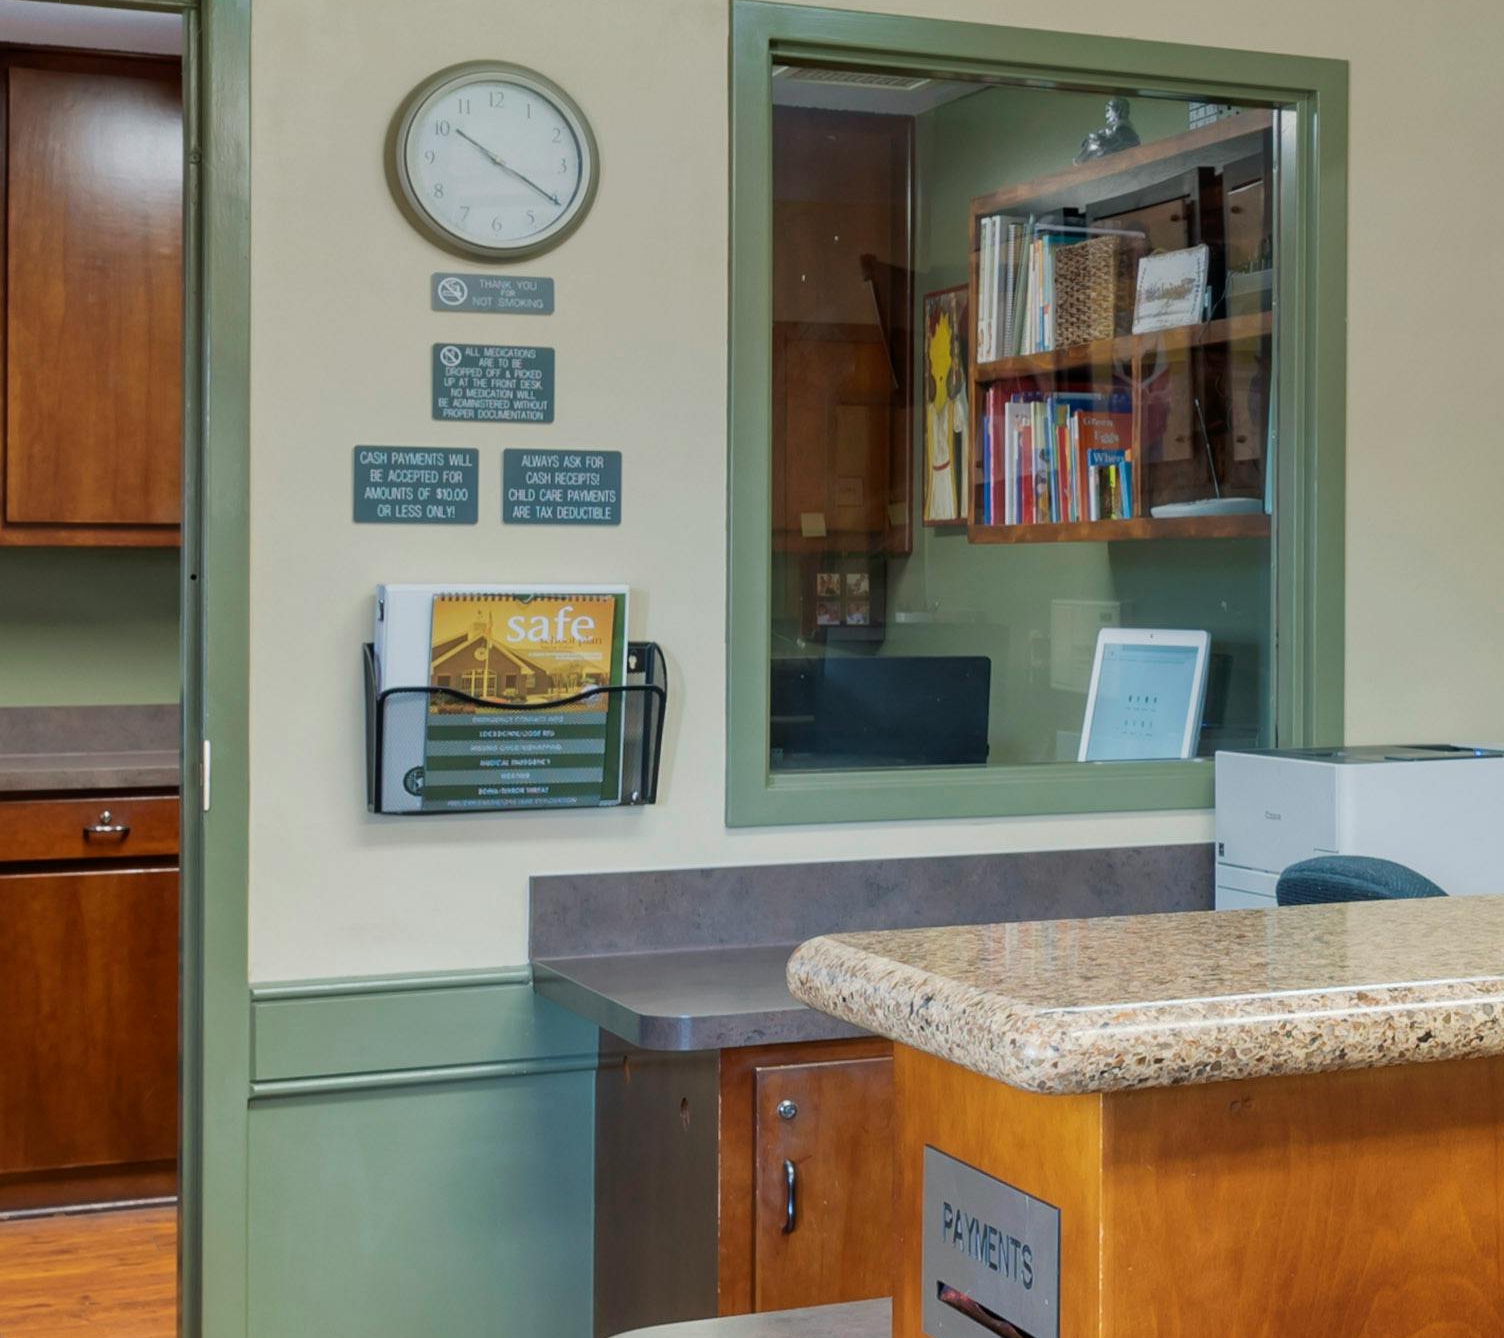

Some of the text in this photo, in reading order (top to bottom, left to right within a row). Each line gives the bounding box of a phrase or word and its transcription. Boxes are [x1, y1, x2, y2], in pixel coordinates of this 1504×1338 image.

[458, 98, 471, 115] 11
[488, 91, 505, 109] 12
[434, 119, 451, 136] 10
[551, 127, 562, 143] 2
[424, 149, 436, 165] 9
[558, 158, 567, 174] 3
[433, 182, 444, 199] 8
[459, 205, 471, 222] 7
[527, 209, 536, 226] 5
[491, 216, 503, 232] 6
[479, 278, 538, 291] THANK YOU
[500, 289, 516, 297] FOR
[471, 296, 544, 309] NOT SMOKING
[464, 347, 537, 359] ALL MEDICATIONS
[478, 358, 523, 369] ARE TO BE
[445, 367, 483, 378] DROPPED
[485, 368, 502, 378] OFF
[514, 369, 542, 379] PICKED
[443, 377, 455, 387] UP
[458, 378, 469, 388] AT
[472, 378, 488, 388] THE
[490, 379, 517, 389] FRONT
[450, 388, 536, 400] NO MEDICATION WILL
[438, 398, 548, 410] BE ADMINISTERED WITHOUT
[442, 409, 544, 421] PROPER DOCUMENTATION
[1083, 416, 1114, 427] Green
[359, 451, 473, 467] CASH PAYMENTS WILL
[521, 454, 604, 469] ALWAYS ASK FOR
[370, 469, 463, 484] BE ACCEPTED FOR
[525, 471, 601, 486] CASH RECEIPTS!
[364, 487, 469, 502] AMOUNTS OF $10.00
[508, 488, 616, 503] CHILD CARE PAYMENTS
[377, 504, 456, 519] OR LESS ONLY!
[512, 505, 612, 520] ARE TAX DEDUCTIBLE
[506, 605, 595, 643] safe
[941, 1201, 1035, 1291] PAYMENTS
